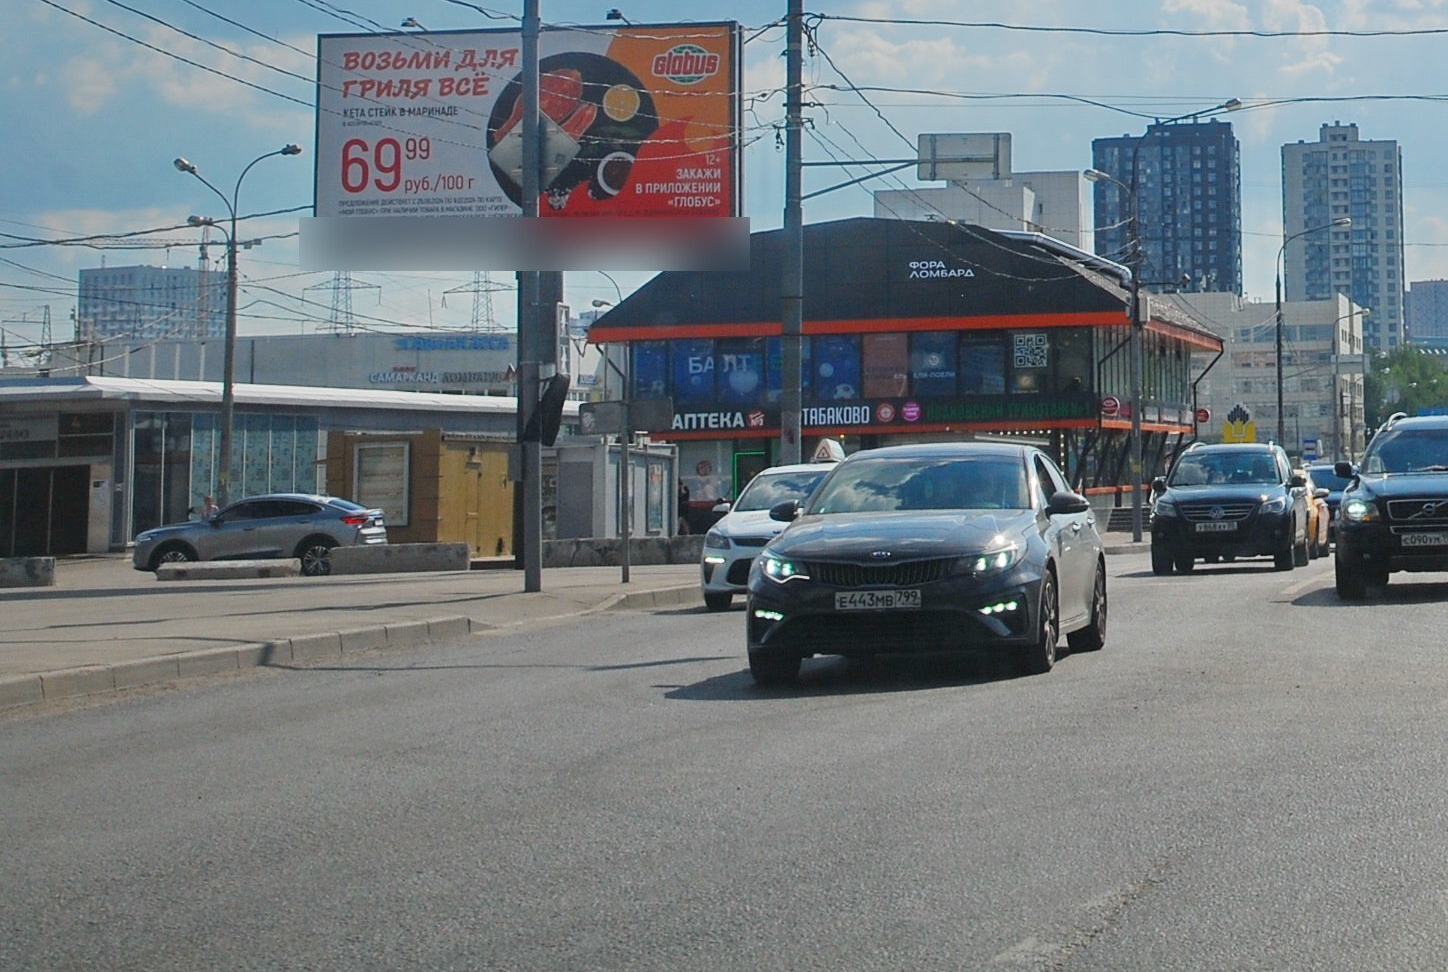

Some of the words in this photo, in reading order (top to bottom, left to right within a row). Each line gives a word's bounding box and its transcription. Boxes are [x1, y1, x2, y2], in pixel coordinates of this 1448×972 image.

[343, 50, 451, 72] ВОЗЬМИ
[455, 48, 519, 72] ДЛЯ
[342, 78, 433, 100] ГРИЛЯ
[438, 71, 490, 97] ВСЁ
[343, 107, 365, 118] КЕТА
[368, 106, 397, 118] СТЕЙК
[409, 106, 459, 117] МАРИНАДЕ
[405, 137, 431, 160] 99
[341, 137, 401, 194] 69
[705, 155, 721, 165] 12+
[676, 168, 721, 180] ЗАКАЖИ
[404, 173, 464, 195] руб./100
[468, 177, 475, 190] г
[635, 184, 643, 194] В
[645, 182, 721, 194] ПРИЛОЖЕНИИ
[668, 196, 721, 207] «ГЛОБУС»
[909, 260, 946, 270] ФОРА
[909, 269, 975, 279] ЛОМБАРД
[369, 371, 440, 384] САМАРКАНД
[671, 411, 746, 430] АПТЕКА
[802, 405, 870, 426] ТАБАКОВО
[839, 593, 894, 608] Е443МВ
[896, 591, 918, 602] 799
